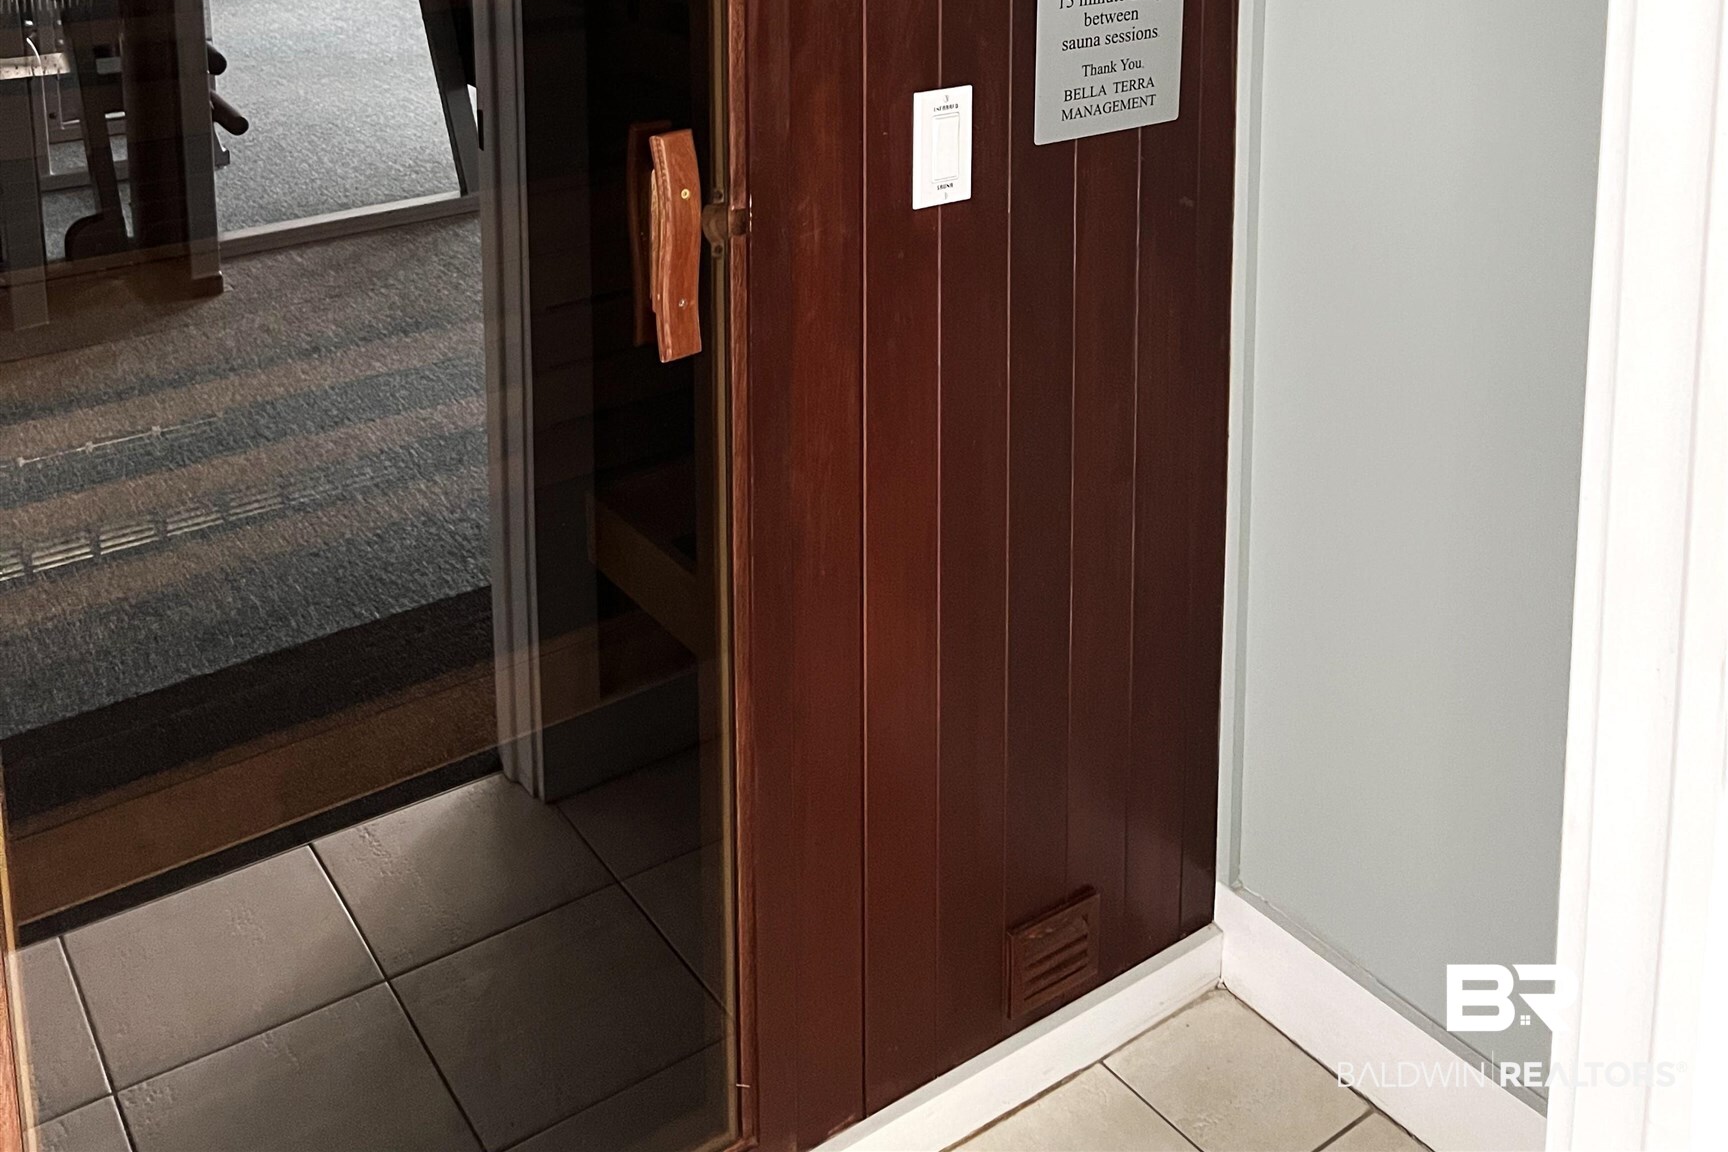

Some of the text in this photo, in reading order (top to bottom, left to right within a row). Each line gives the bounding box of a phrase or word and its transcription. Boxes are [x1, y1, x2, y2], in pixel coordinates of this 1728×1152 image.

[1084, 9, 1139, 27] between
[1061, 35, 1101, 52] sauna
[1081, 60, 1118, 77] Thank
[1063, 76, 1155, 102] BELLA TERRA
[1061, 94, 1157, 122] MANAGEMENT
